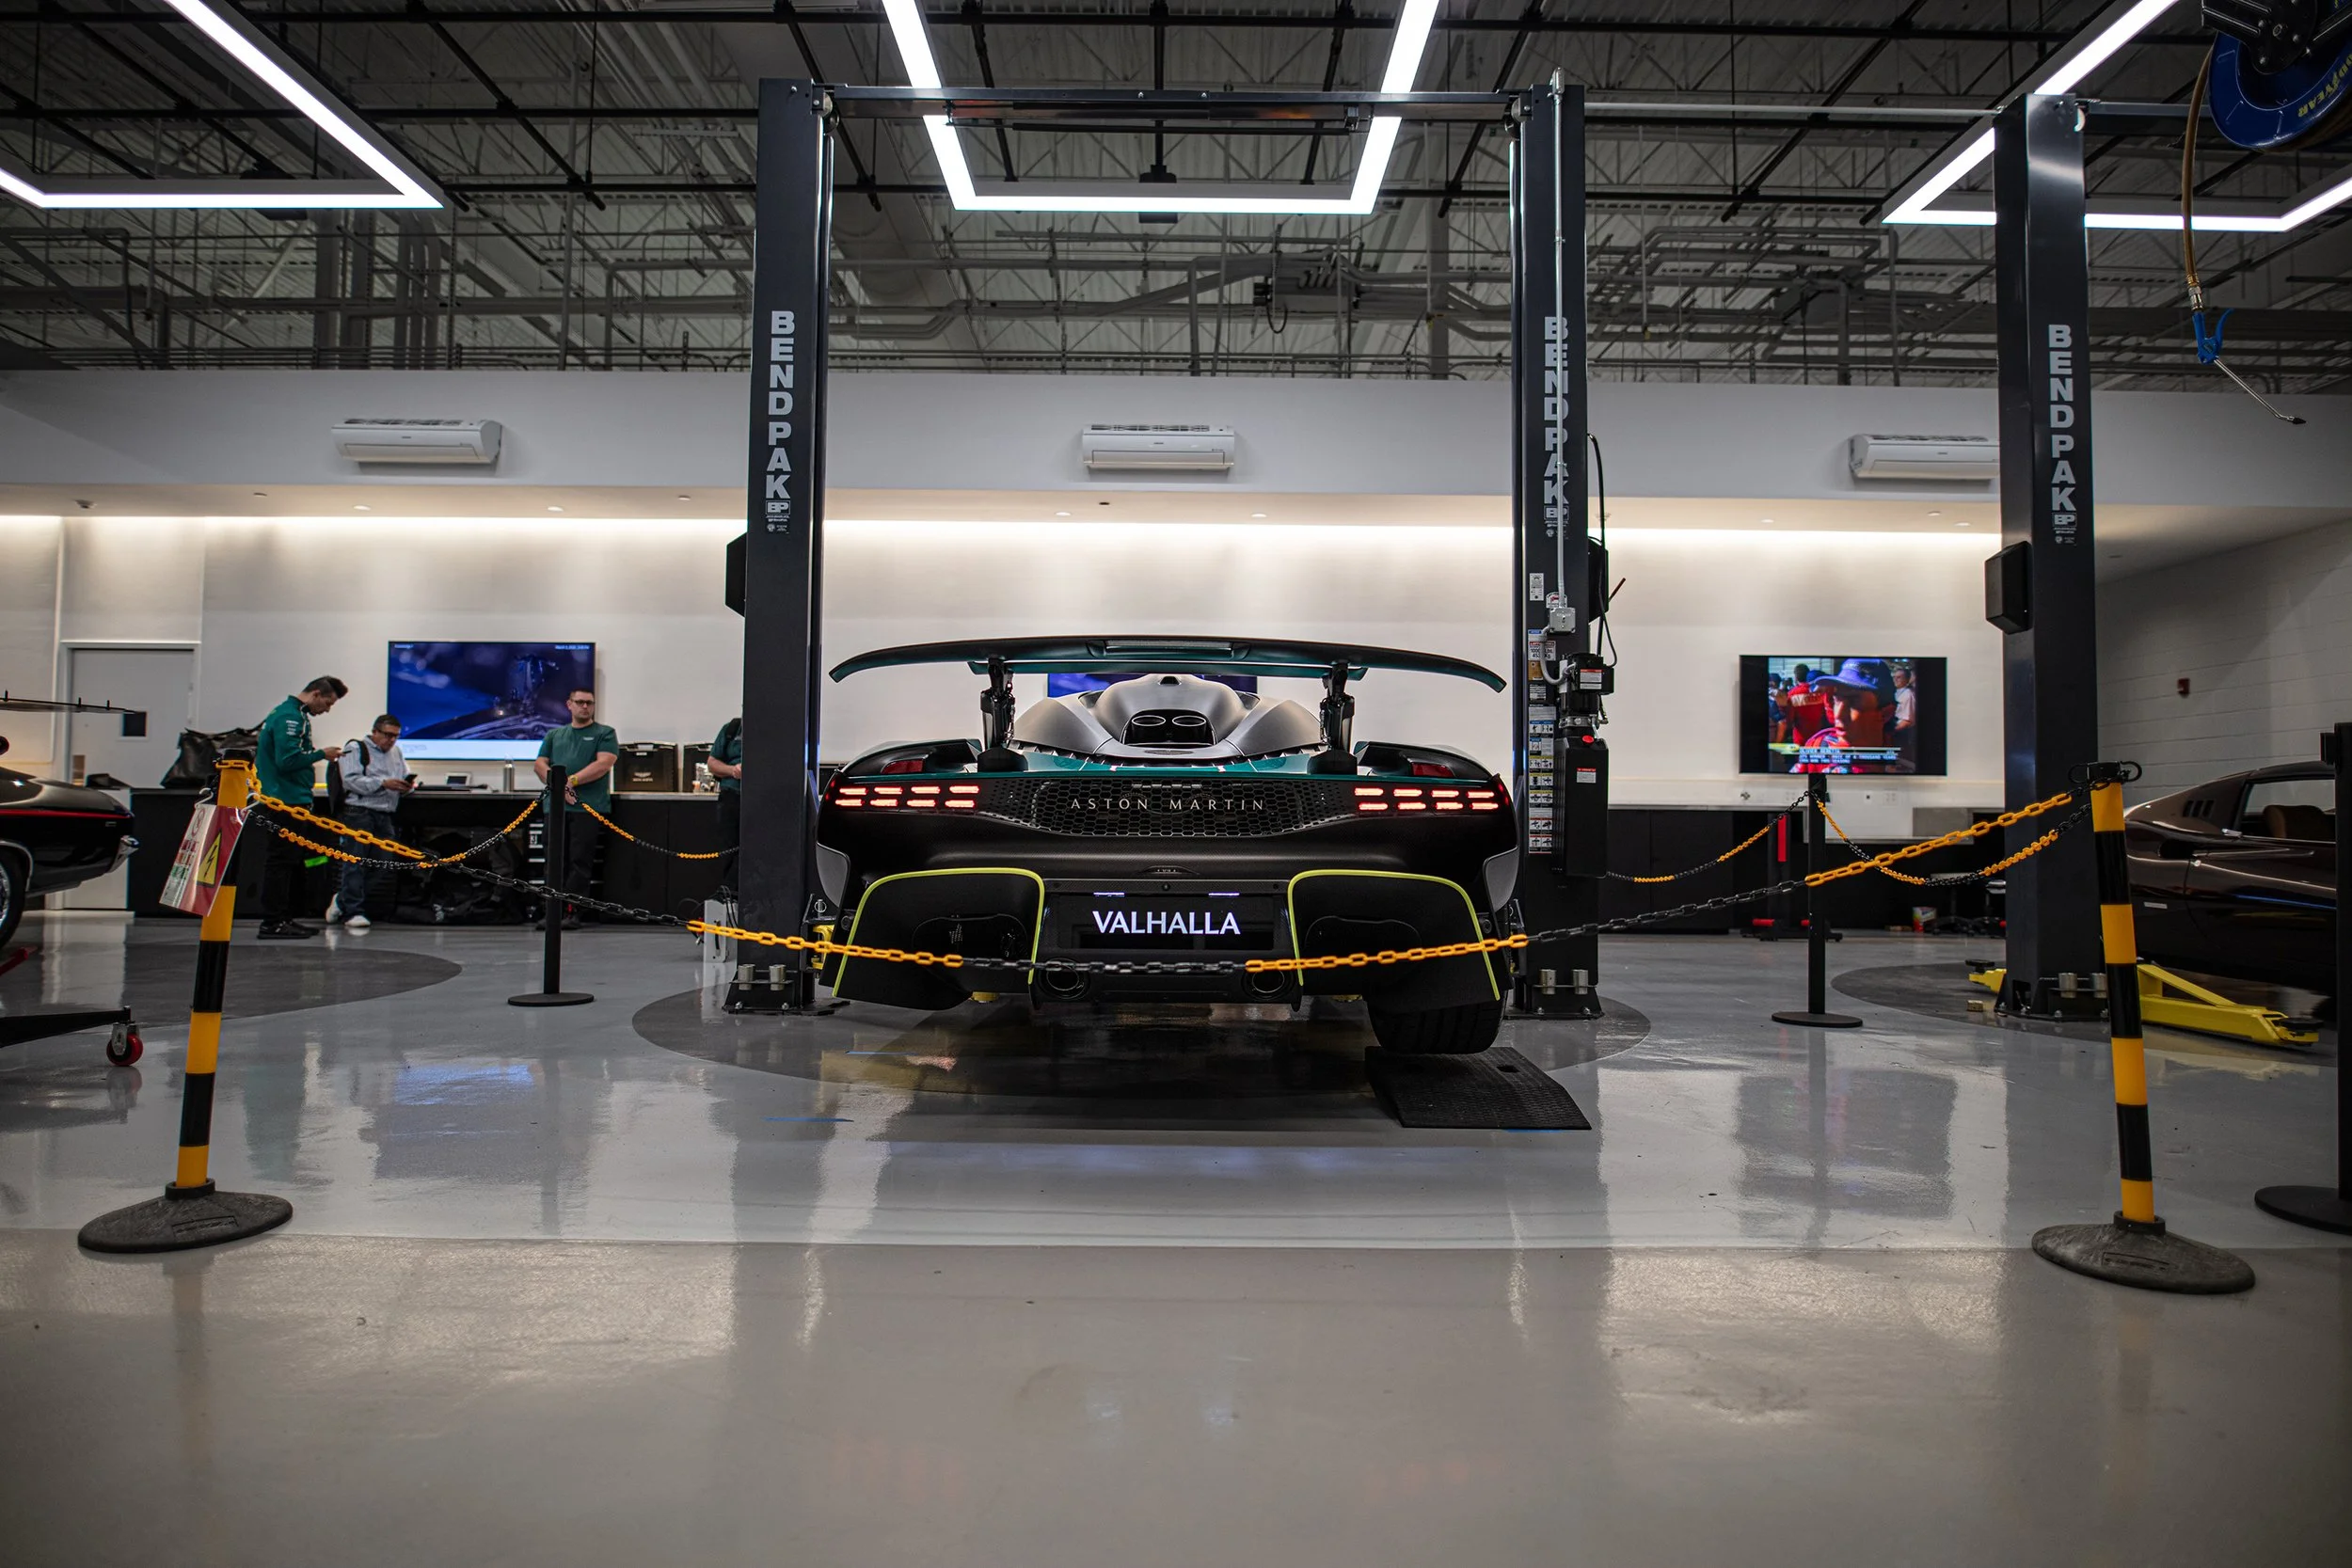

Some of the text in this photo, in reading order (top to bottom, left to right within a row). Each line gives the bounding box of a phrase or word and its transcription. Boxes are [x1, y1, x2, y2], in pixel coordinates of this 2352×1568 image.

[765, 310, 796, 499] BENDPAK
[1543, 316, 1569, 504] BENDPAK
[2047, 324, 2076, 511] BENDPAK
[767, 502, 789, 514] BP
[2054, 515, 2075, 525] BP
[1071, 798, 1263, 810] ASTON MARTIN
[1092, 911, 1241, 935] VALHALLA
